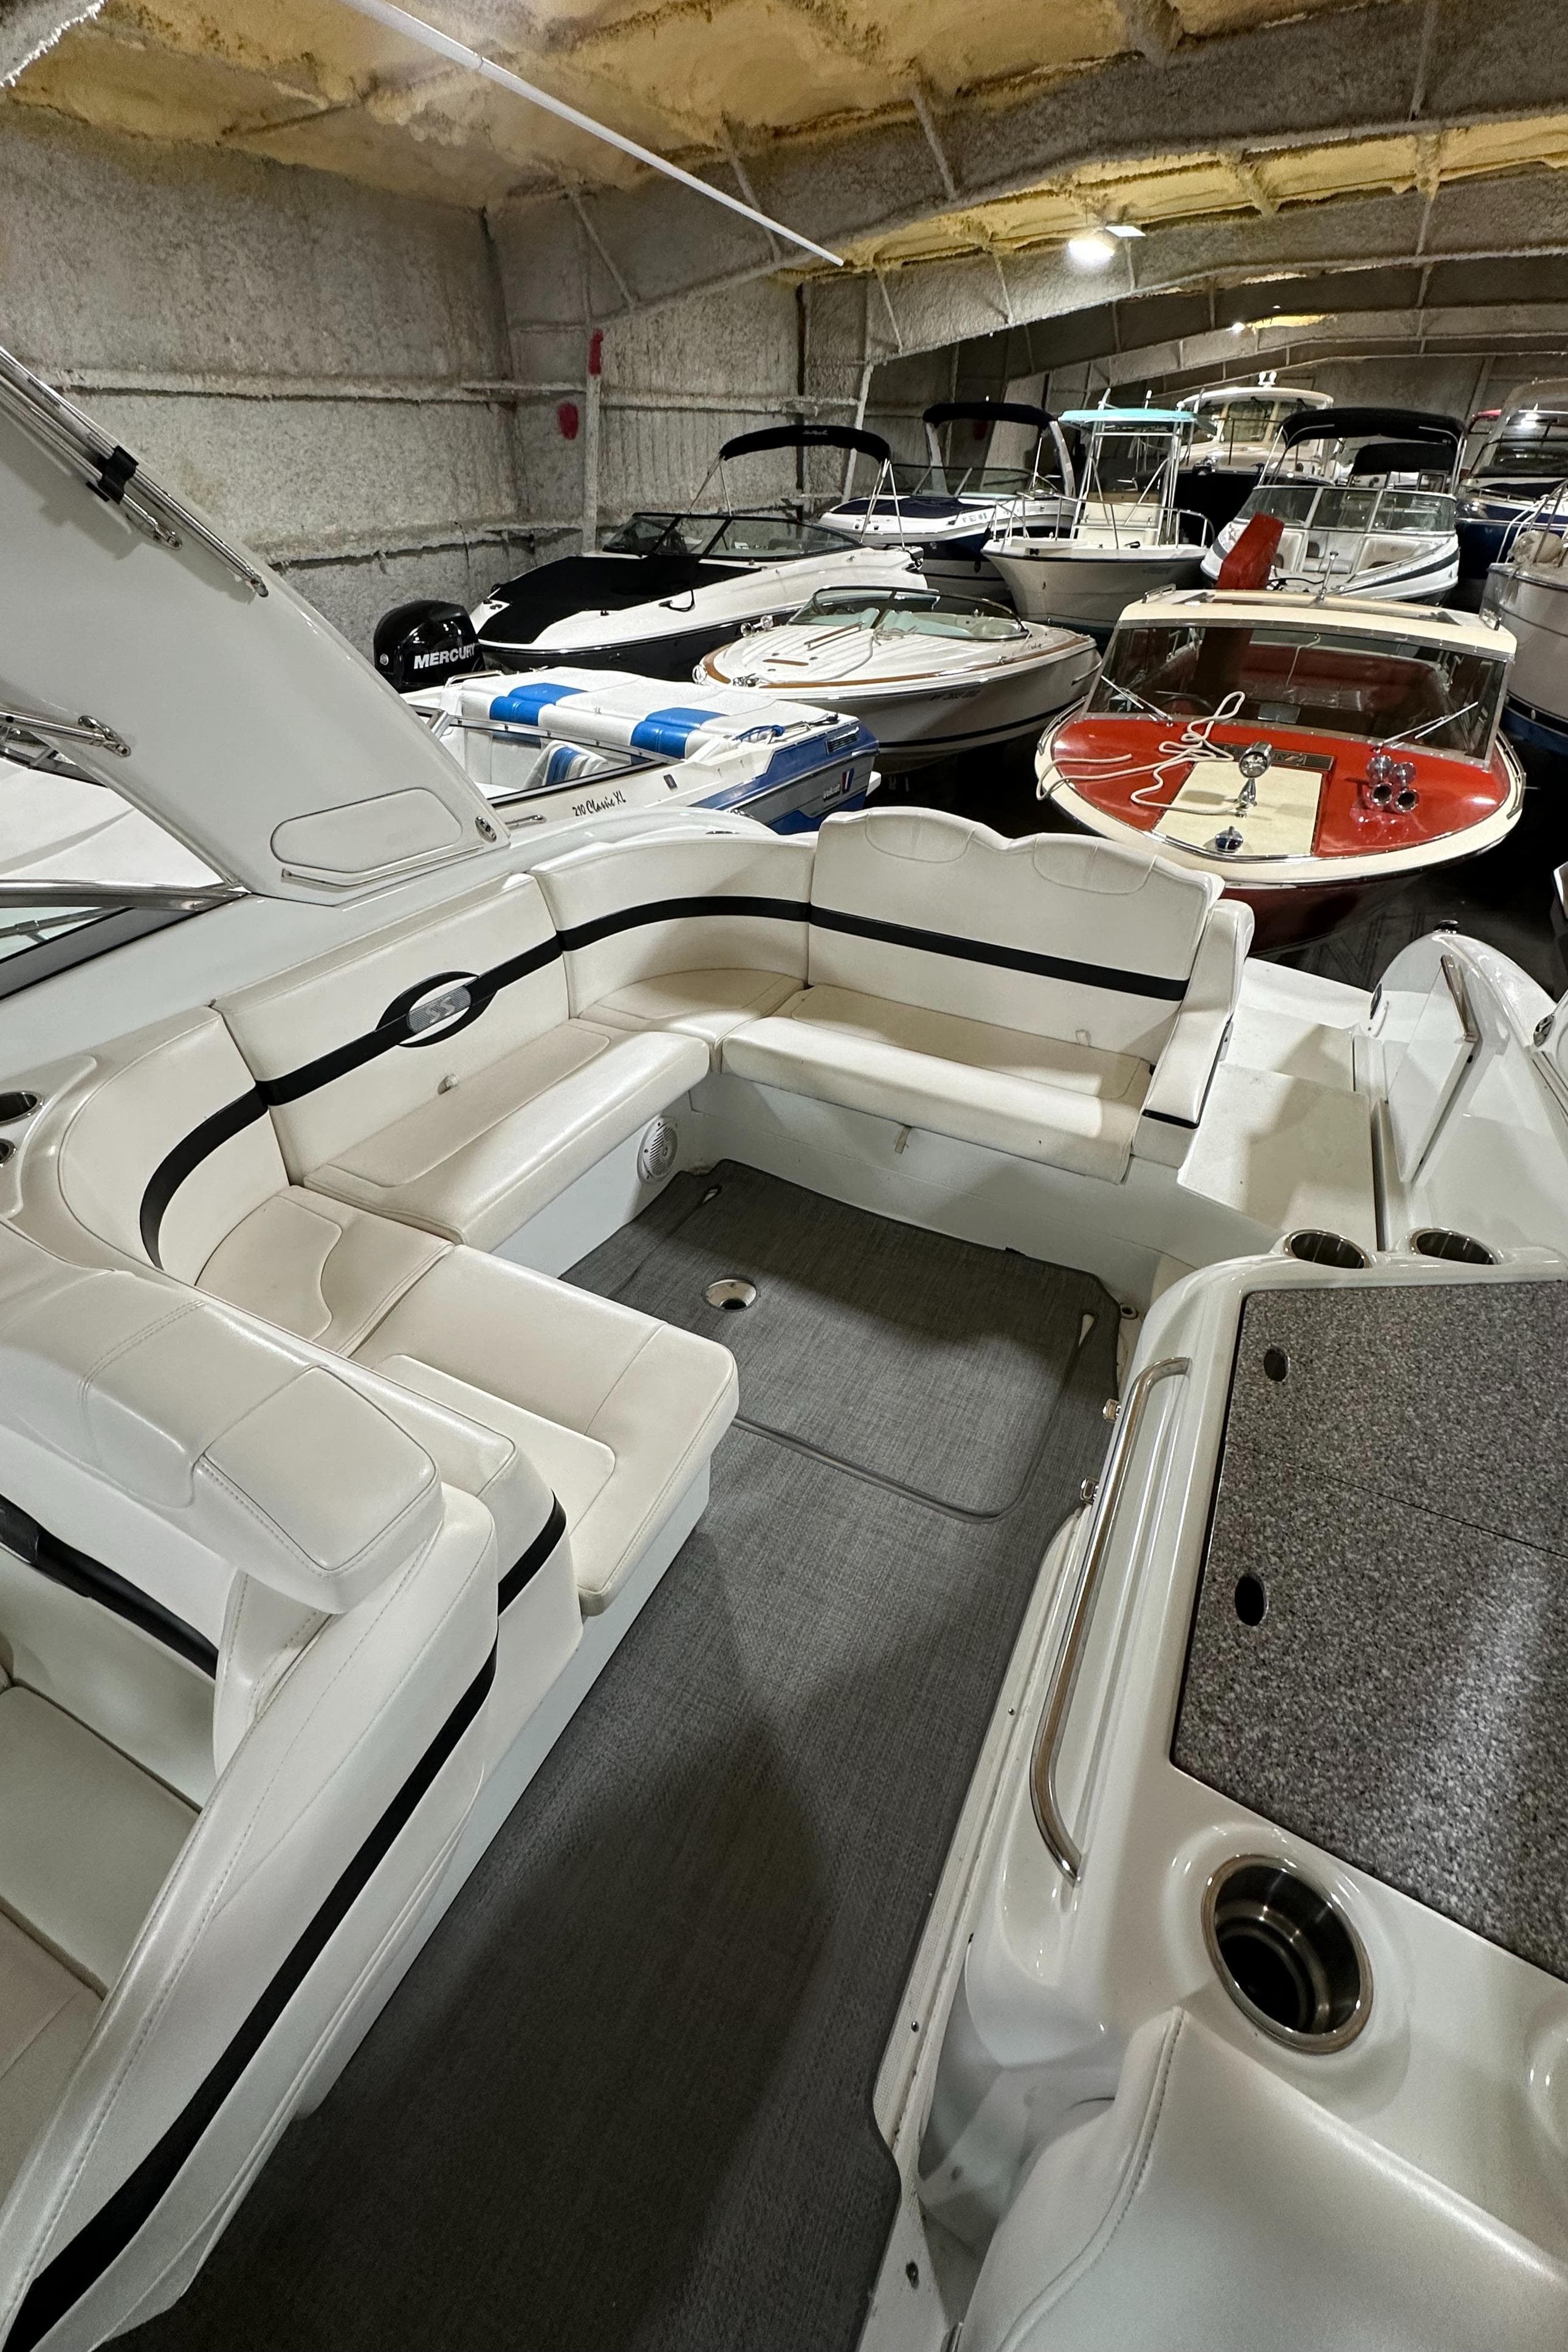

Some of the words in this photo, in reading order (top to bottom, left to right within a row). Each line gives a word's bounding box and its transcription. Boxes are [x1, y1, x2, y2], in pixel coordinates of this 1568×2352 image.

[413, 643, 475, 669] MERCURY
[572, 804, 586, 816] 210
[586, 796, 615, 814] Classic
[613, 790, 627, 805] XL
